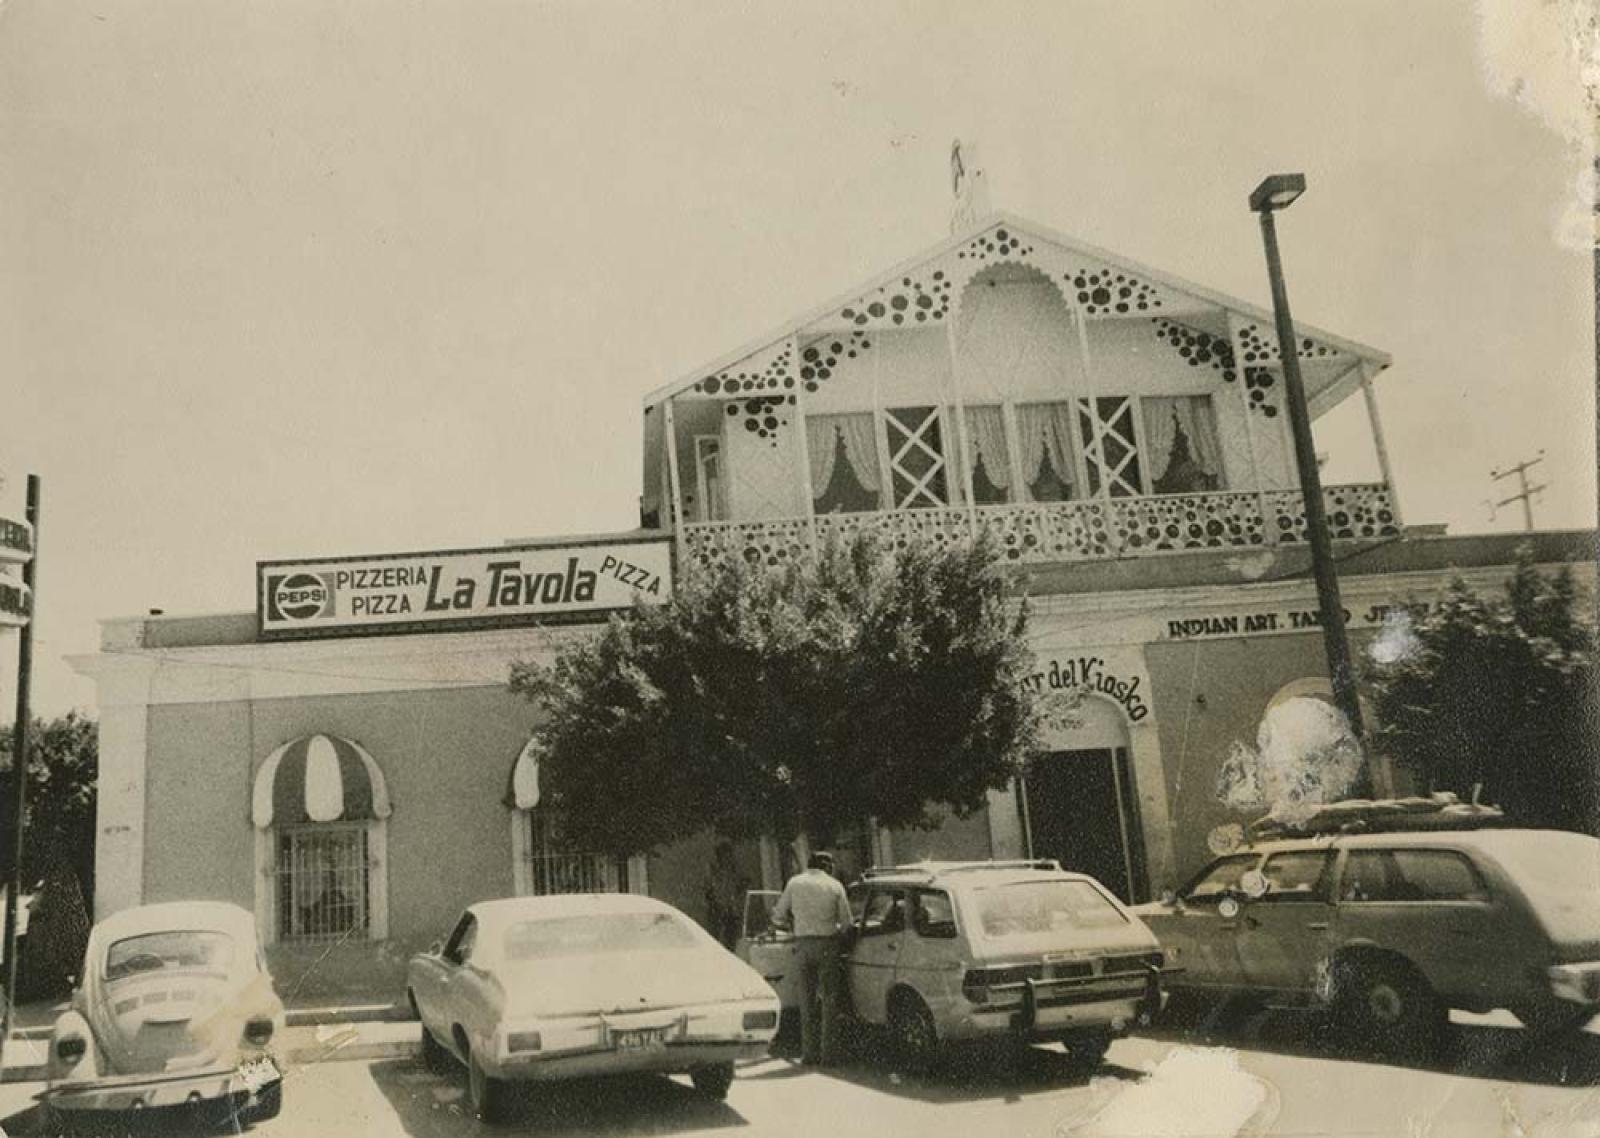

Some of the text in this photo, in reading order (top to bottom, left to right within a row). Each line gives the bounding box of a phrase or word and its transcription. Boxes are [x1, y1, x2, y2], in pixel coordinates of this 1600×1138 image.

[337, 566, 427, 589] PIZZERIA
[424, 557, 597, 611] La Tavola
[600, 554, 661, 595] PIZZA
[278, 588, 327, 604] PEPSI
[352, 594, 411, 616] PIZZA
[1167, 615, 1238, 638] INDIAN
[1049, 659, 1078, 689] del
[1078, 657, 1148, 722] Kiosko
